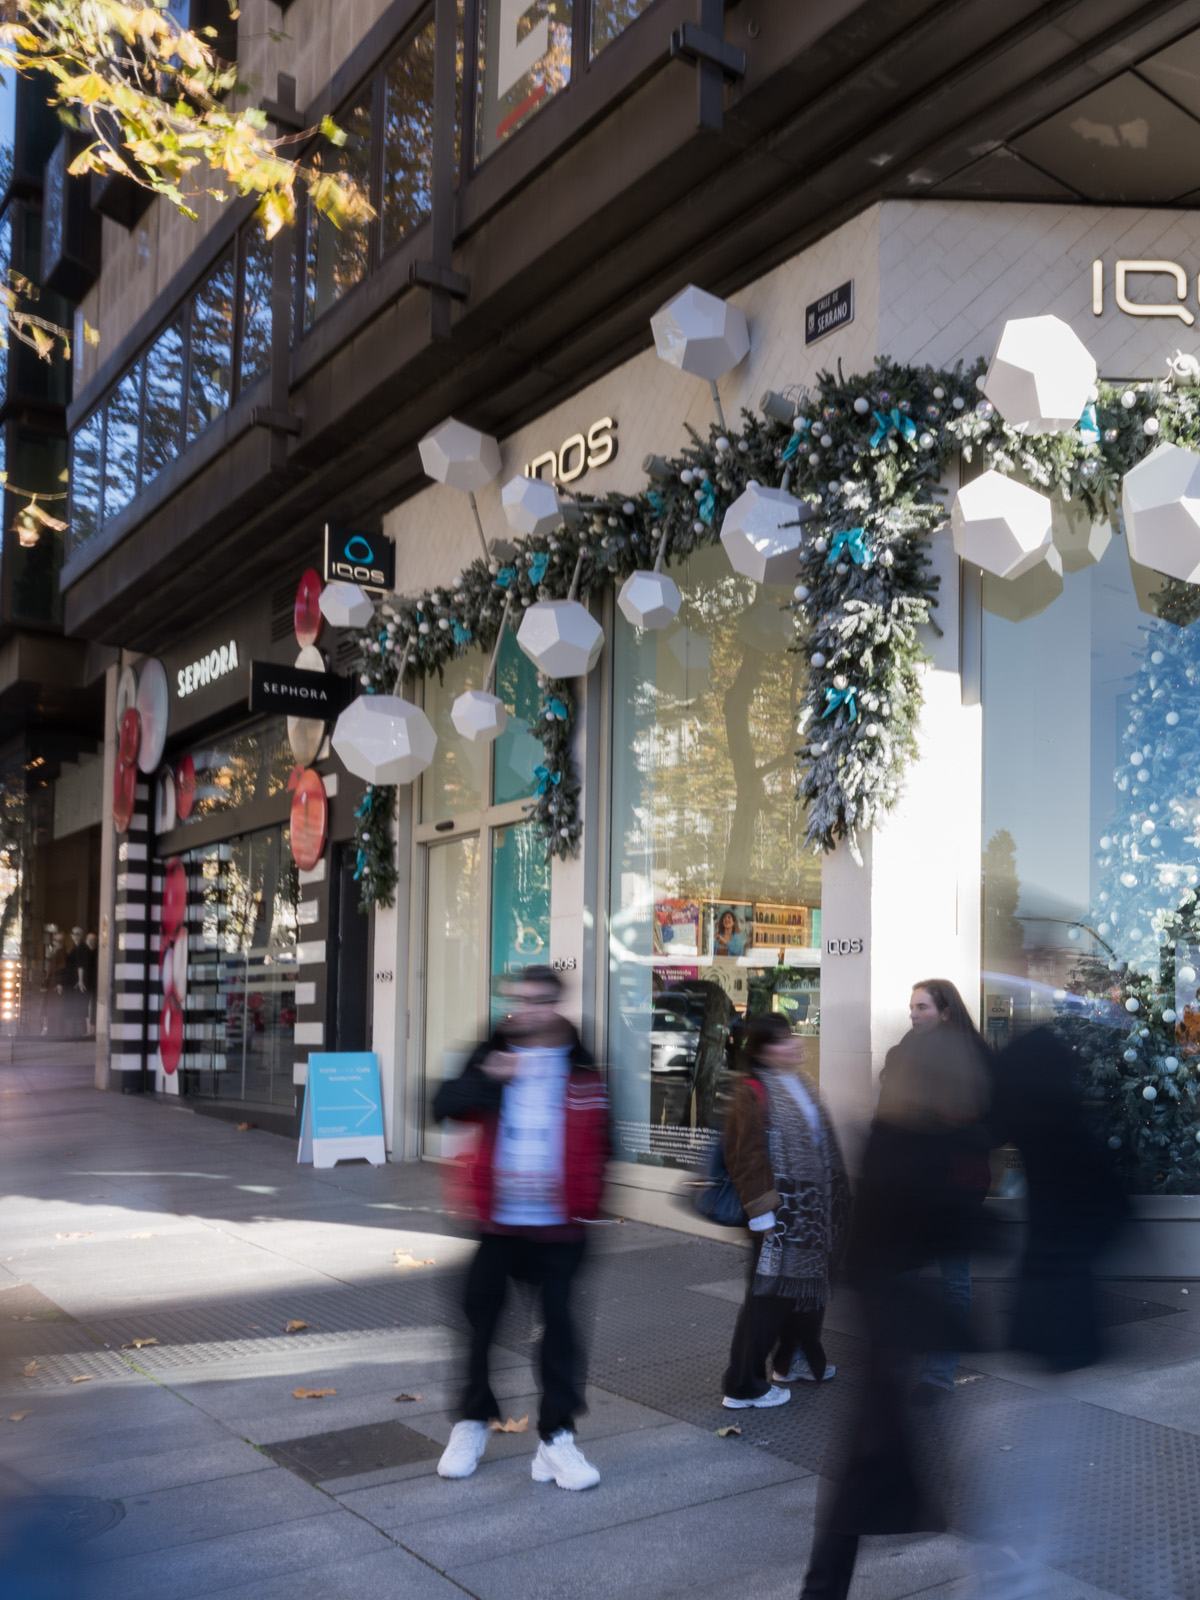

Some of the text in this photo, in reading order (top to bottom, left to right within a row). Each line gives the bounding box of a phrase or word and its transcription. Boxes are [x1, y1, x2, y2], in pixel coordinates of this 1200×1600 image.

[817, 301, 848, 334] SERRANO
[331, 561, 385, 585] IQOS
[177, 639, 239, 698] SEPHORA
[263, 681, 328, 701] SEPHORA
